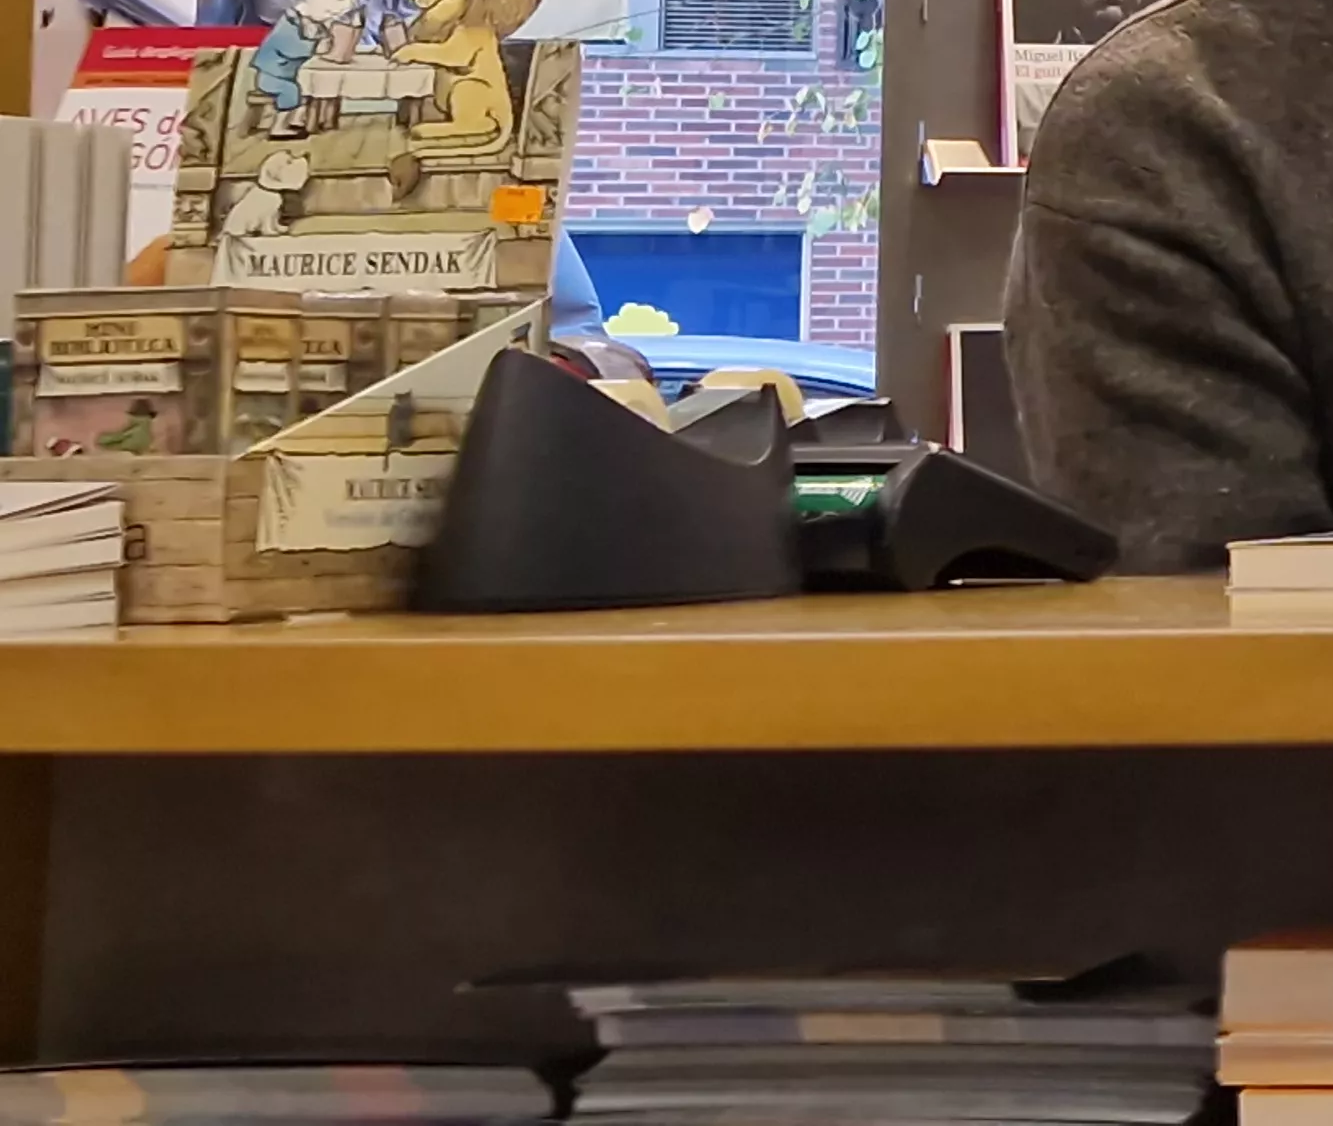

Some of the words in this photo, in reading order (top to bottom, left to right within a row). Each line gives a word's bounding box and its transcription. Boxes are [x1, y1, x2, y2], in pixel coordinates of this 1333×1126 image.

[1015, 49, 1063, 63] Miguel
[1015, 65, 1030, 78] El
[248, 252, 357, 277] MAURICE
[365, 249, 462, 275] SENDAK
